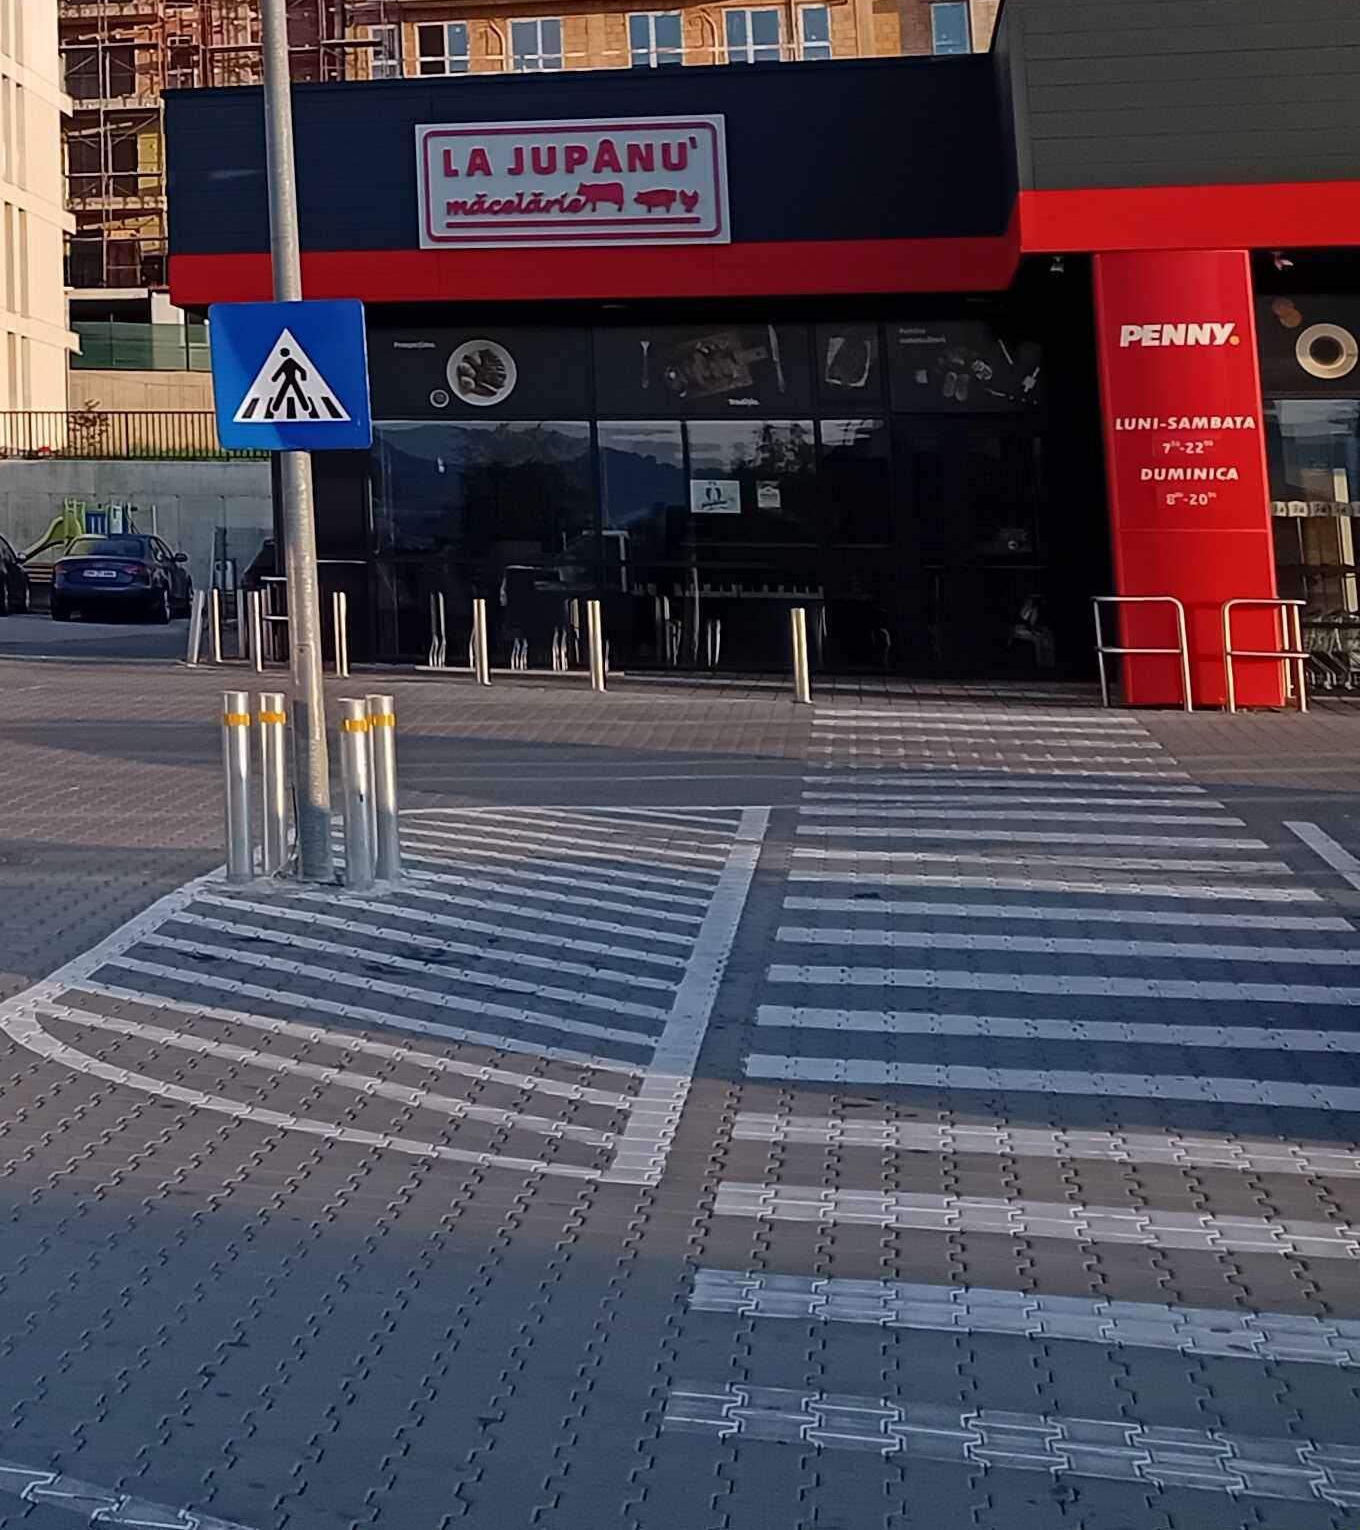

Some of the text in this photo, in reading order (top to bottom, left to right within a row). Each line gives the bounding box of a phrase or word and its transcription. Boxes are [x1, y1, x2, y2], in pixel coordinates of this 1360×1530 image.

[443, 147, 493, 178] LA
[1115, 416, 1256, 431] LUNI-SAMBATA
[1140, 467, 1239, 481] DUMINICA
